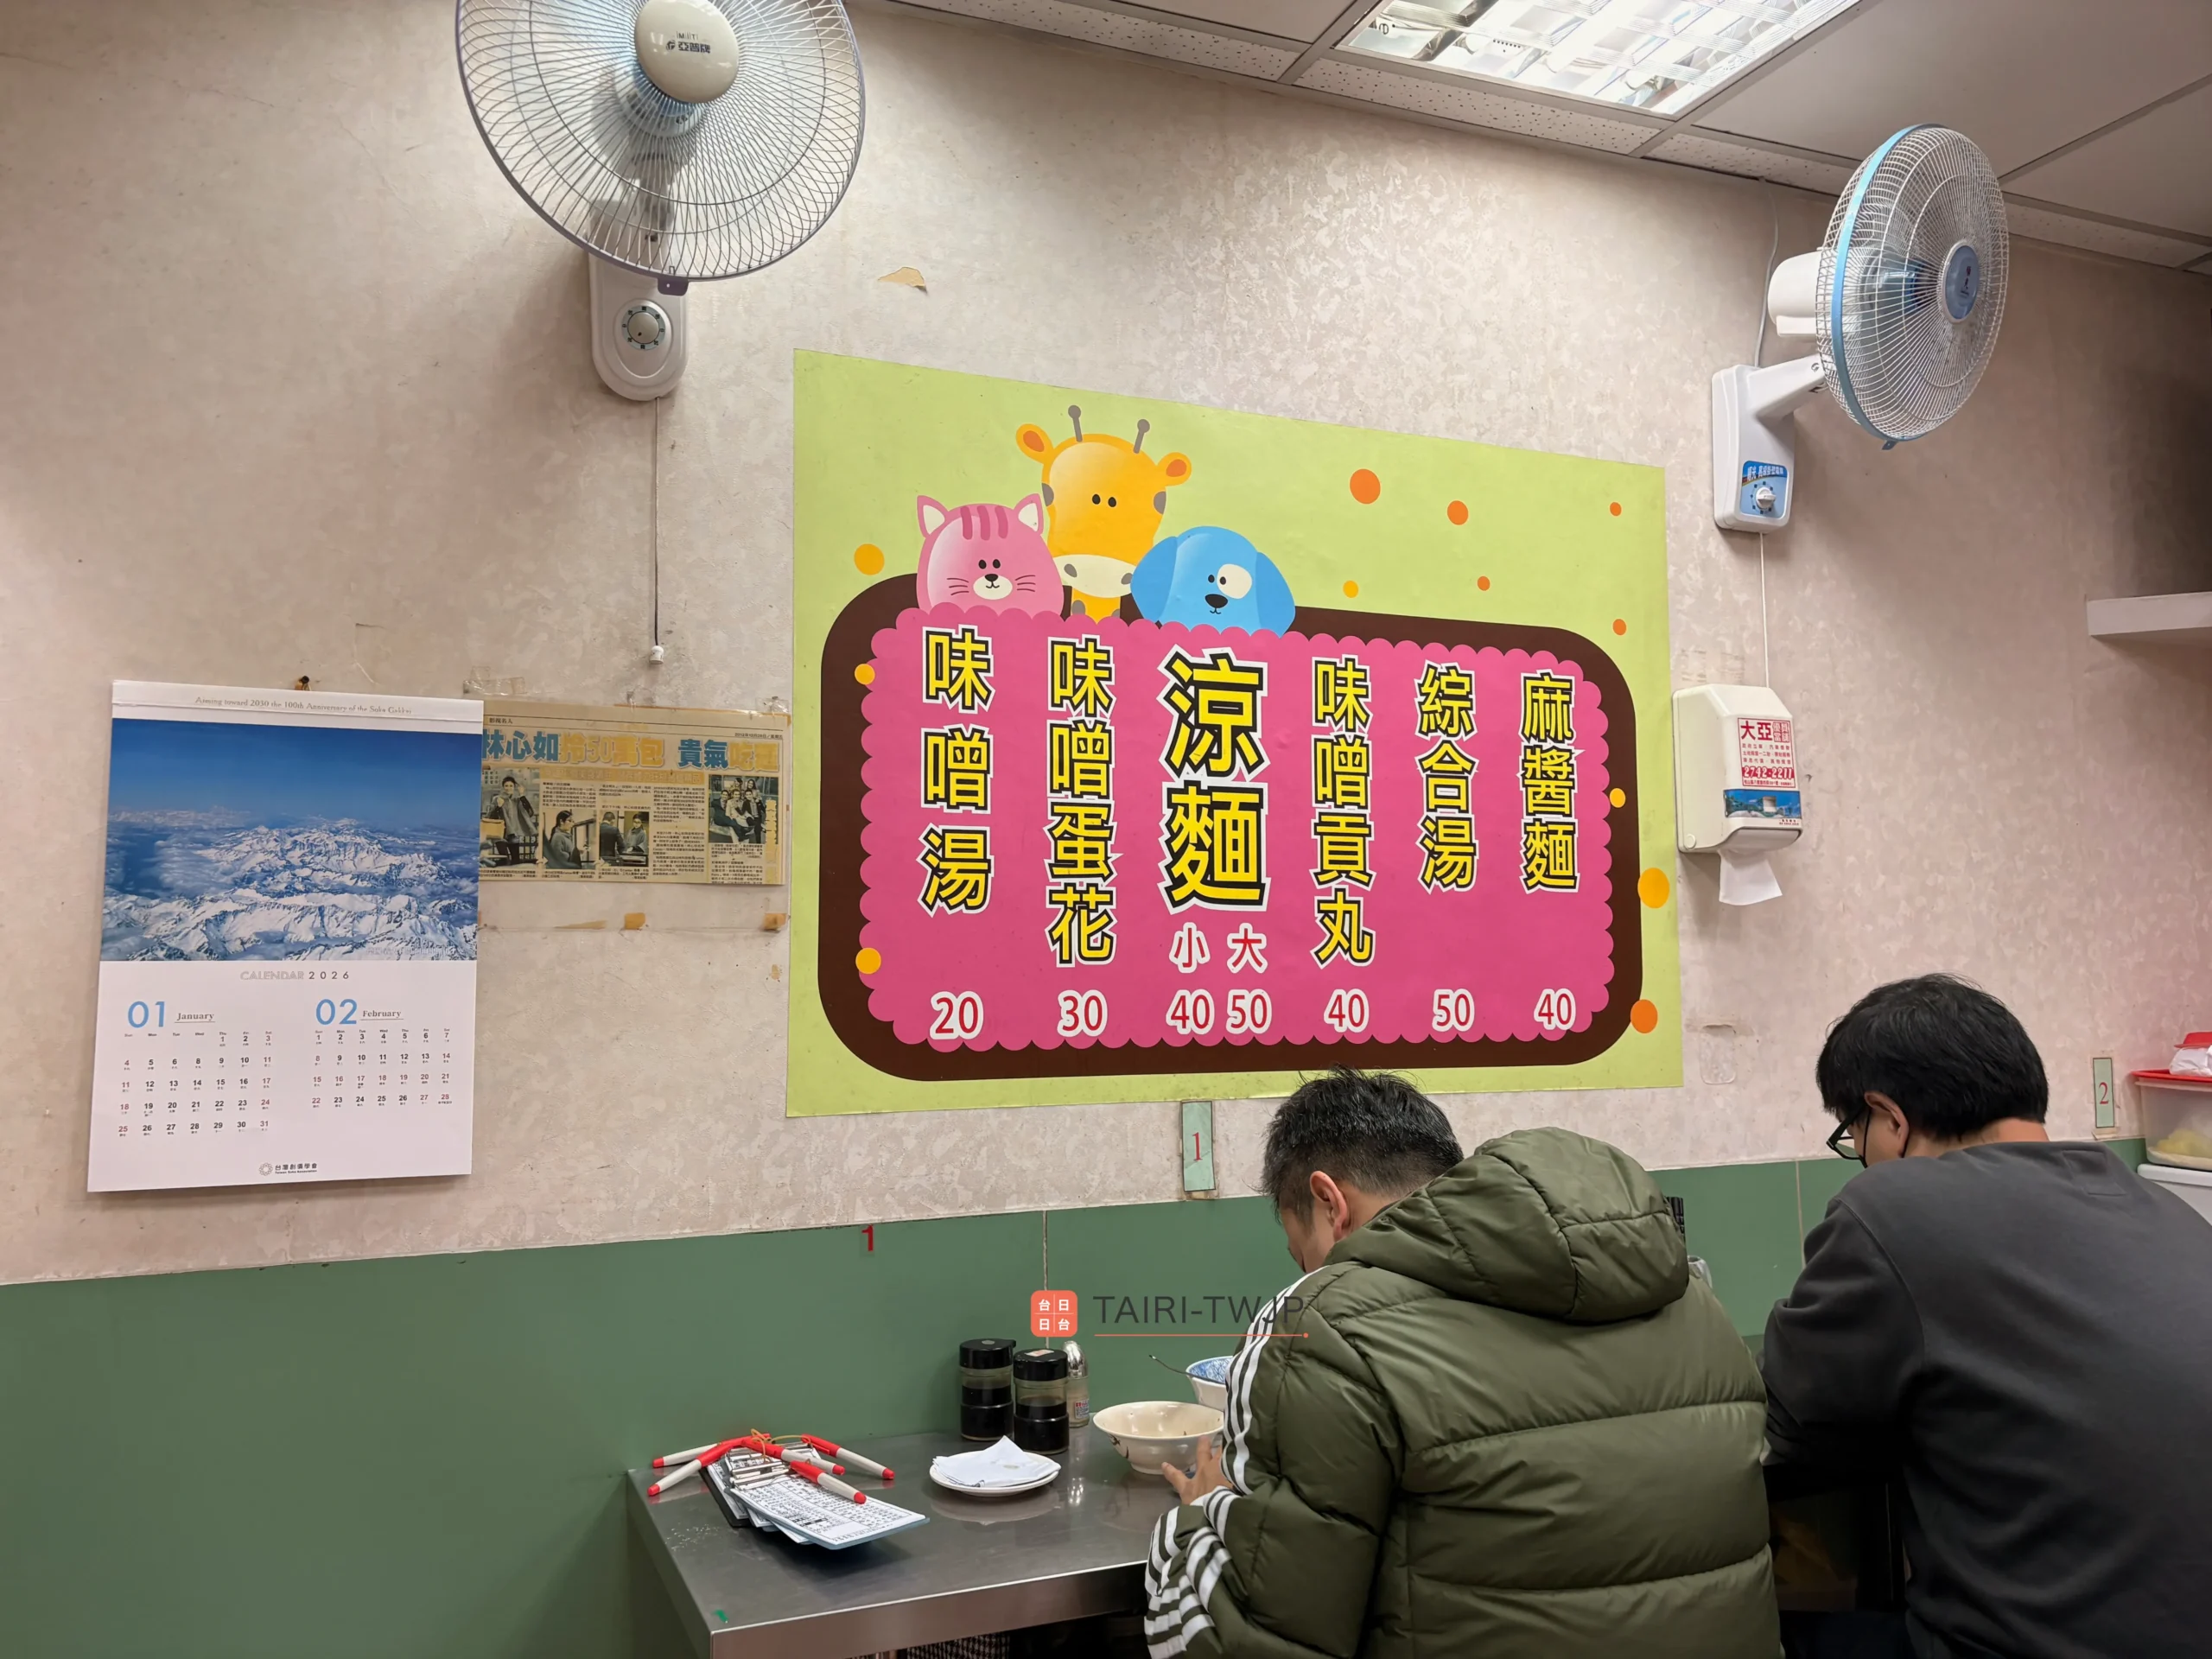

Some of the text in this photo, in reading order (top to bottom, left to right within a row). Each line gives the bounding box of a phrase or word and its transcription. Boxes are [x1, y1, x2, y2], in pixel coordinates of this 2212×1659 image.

[195, 696, 222, 706] Aiming
[284, 701, 304, 709] 100th
[306, 703, 347, 712] Anniversary
[1741, 721, 1772, 741] 大亞
[918, 626, 995, 915] 味噌湯
[1157, 644, 1270, 914] 涼麵
[1415, 660, 1477, 893] 綜合湯
[1518, 669, 1583, 893] 麻醬麵
[1044, 635, 1122, 966] 味噌蛋花
[1311, 655, 1375, 969] 味噌貢丸
[1173, 924, 1266, 972] 小 大
[240, 971, 304, 980] CALENDAR
[128, 1001, 214, 1028] 01 January
[316, 999, 358, 1025] 02
[931, 989, 1574, 1039] 20 30 40 50 40 50 40
[2099, 1082, 2109, 1104] 2
[1192, 1132, 1202, 1161] 1
[861, 1224, 874, 1252] 1
